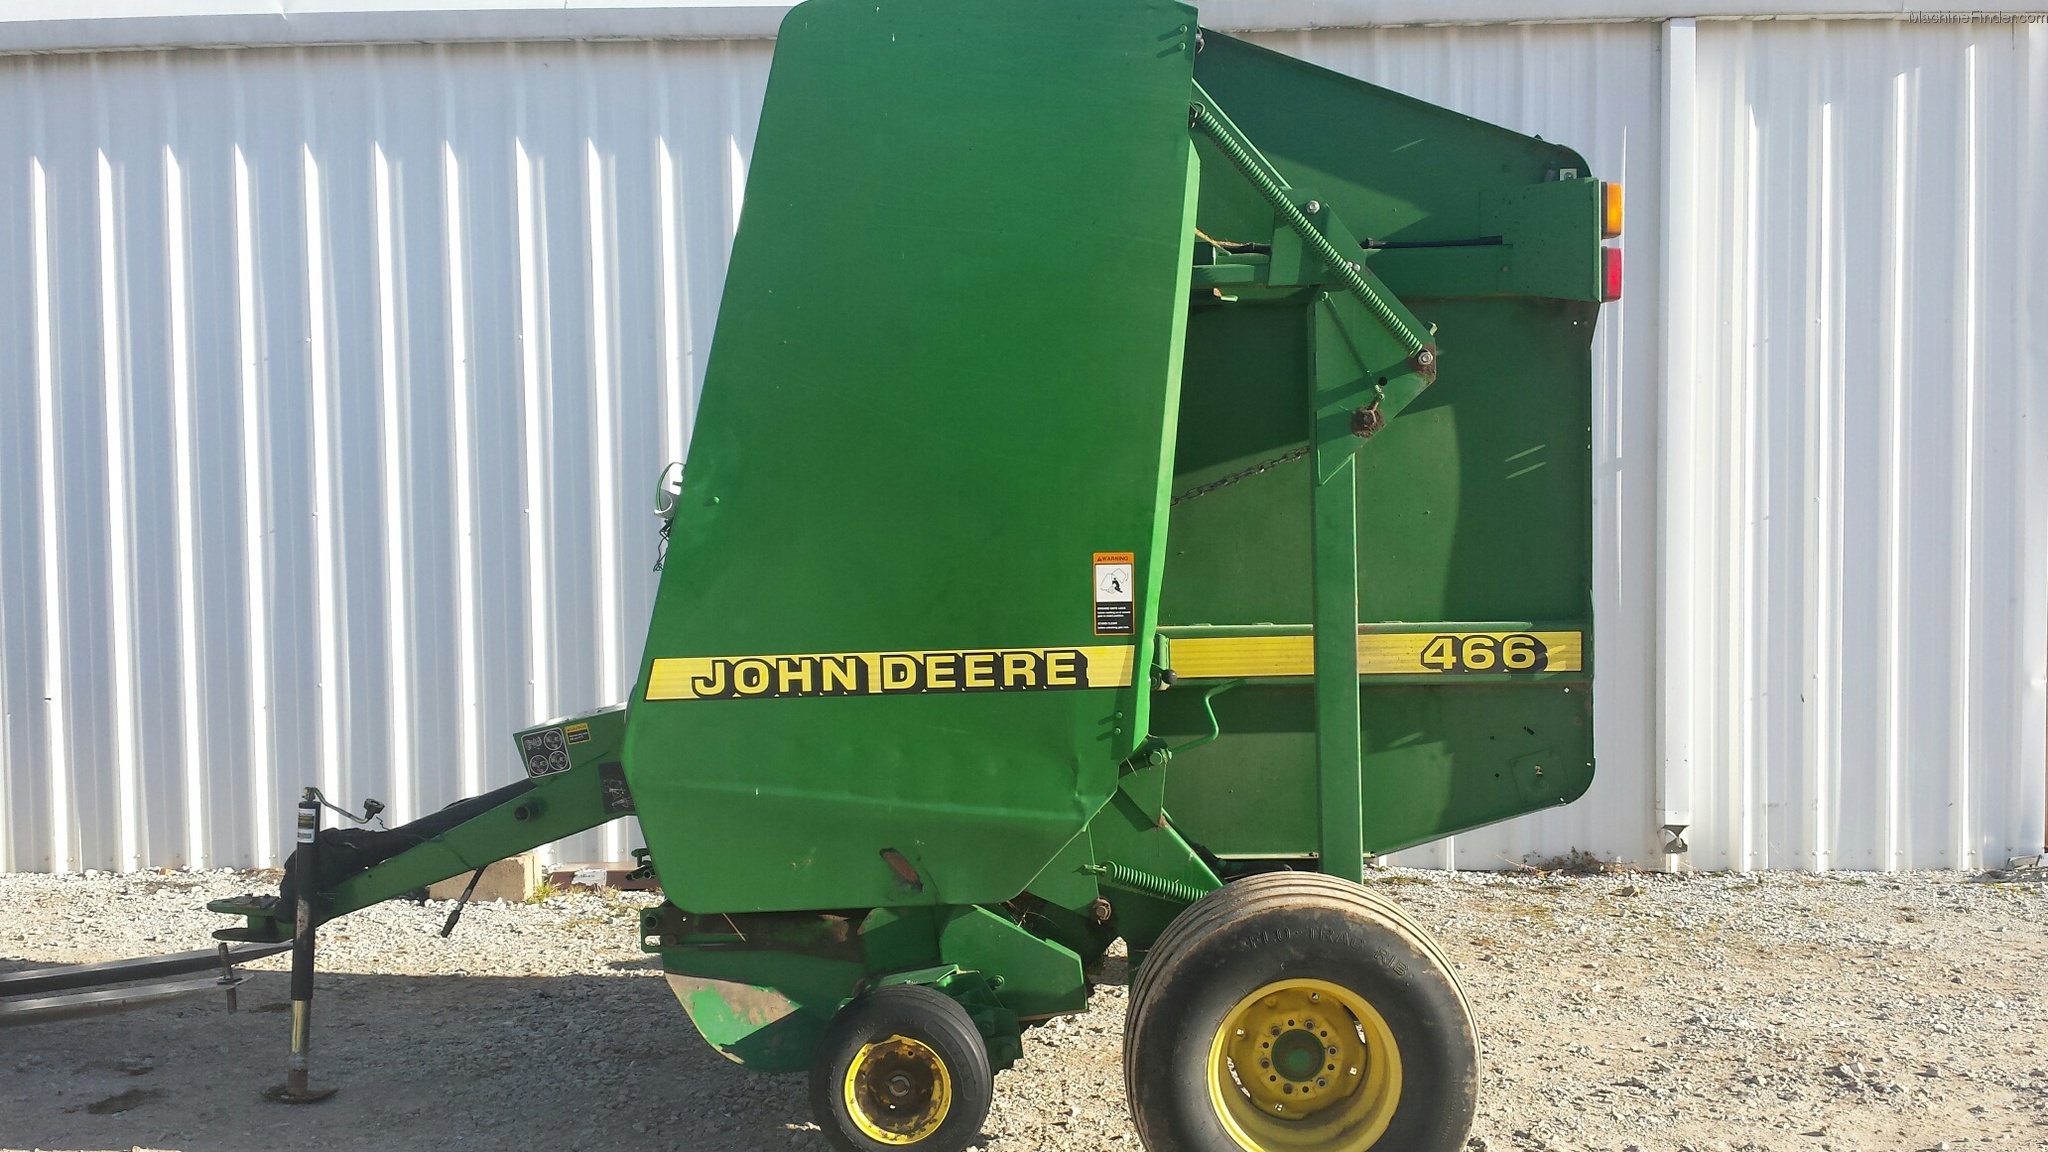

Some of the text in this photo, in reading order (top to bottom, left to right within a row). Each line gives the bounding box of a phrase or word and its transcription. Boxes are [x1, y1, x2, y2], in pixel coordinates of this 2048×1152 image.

[692, 650, 1089, 698] JOHN DEERE
[1421, 635, 1544, 672] 466
